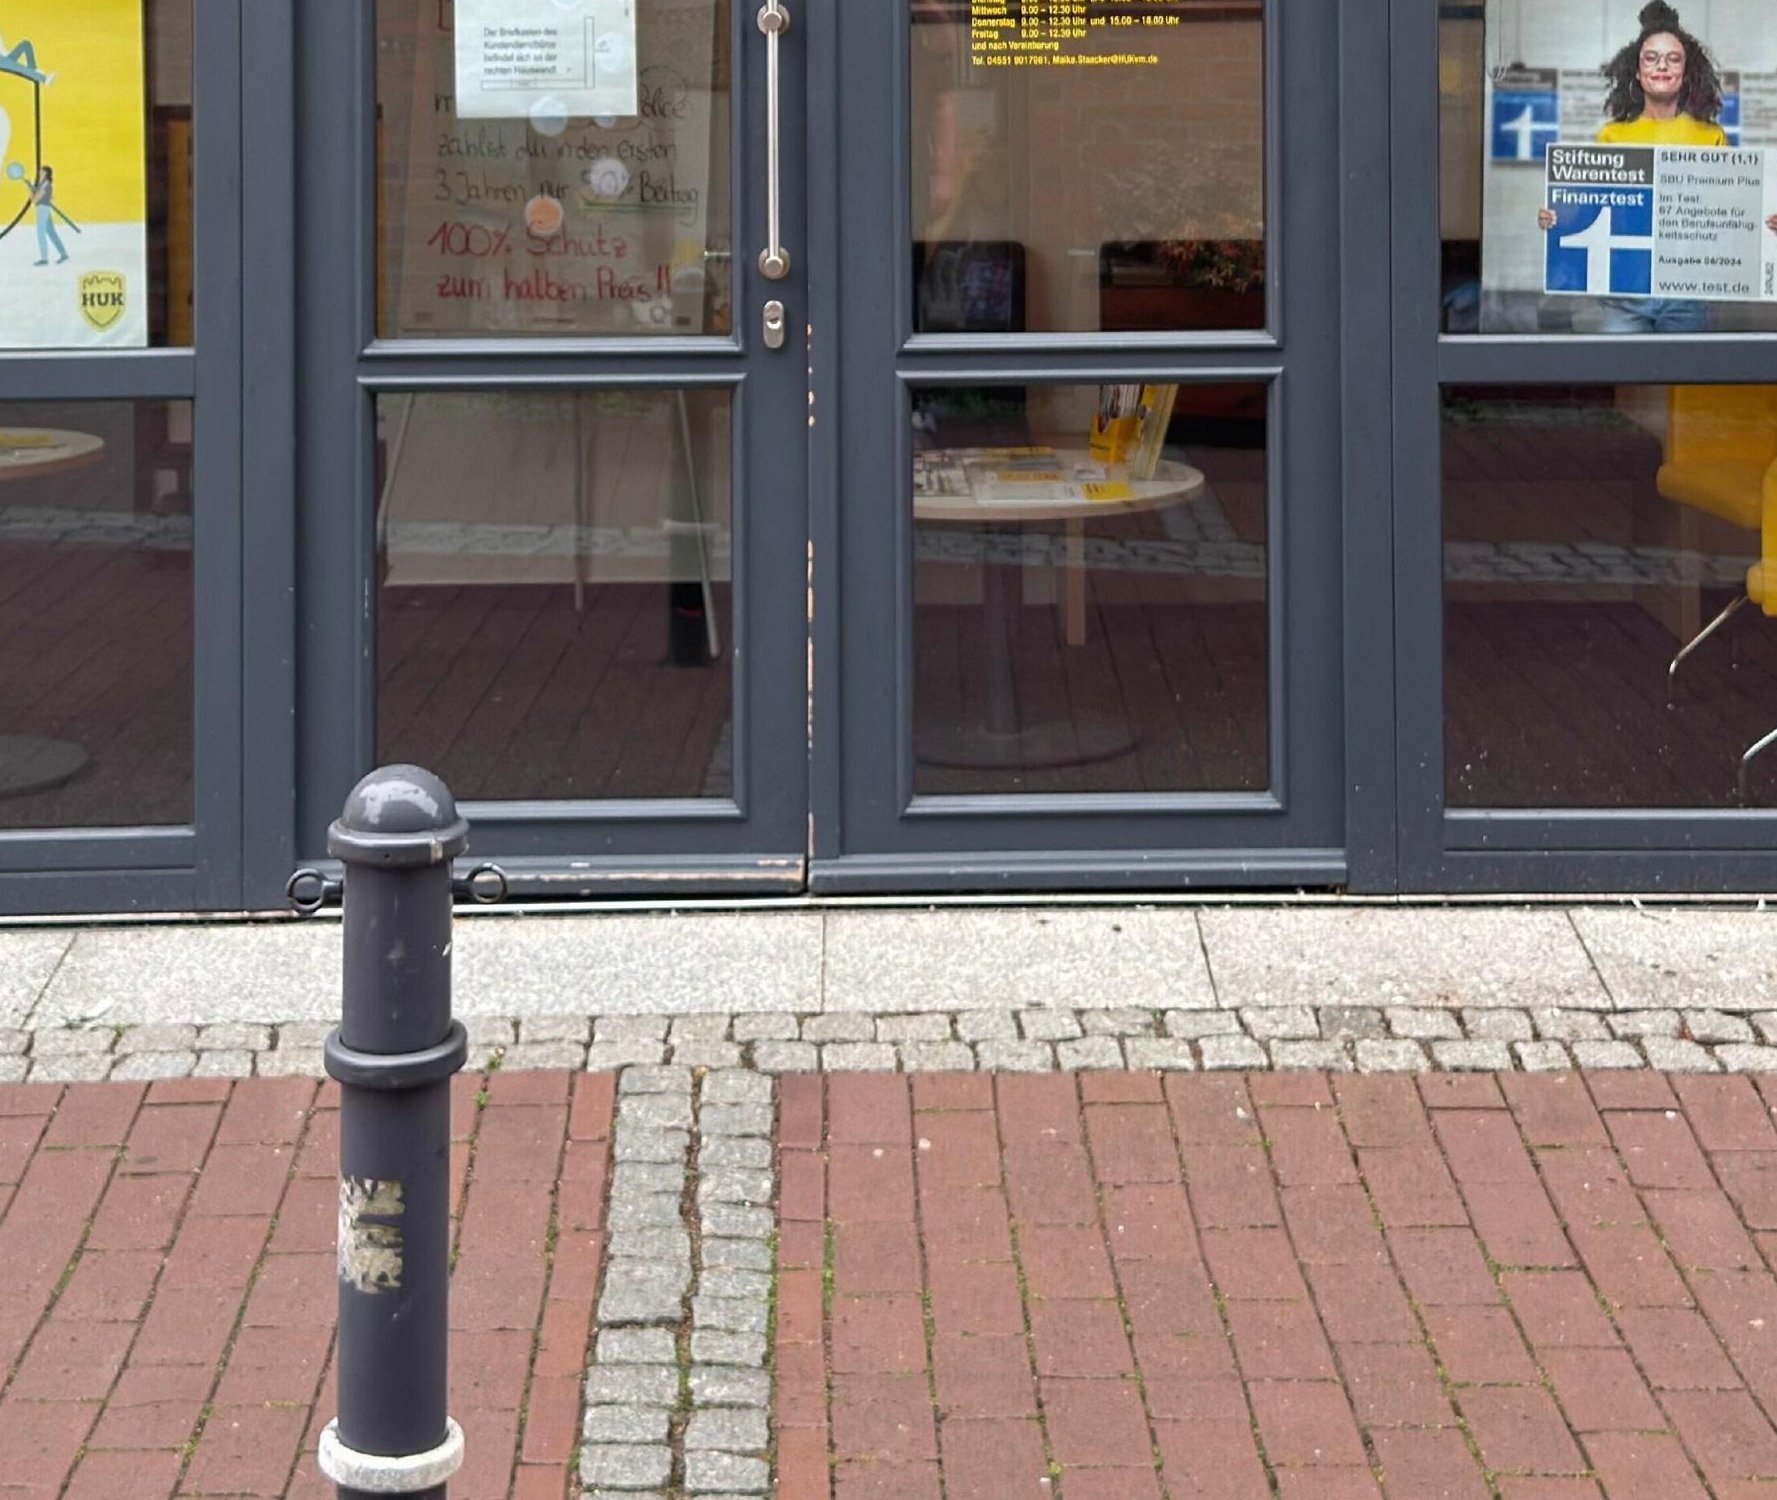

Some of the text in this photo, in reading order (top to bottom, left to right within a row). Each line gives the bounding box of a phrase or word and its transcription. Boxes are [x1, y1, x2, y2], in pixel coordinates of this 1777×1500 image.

[972, 5, 1007, 15] Mittwoch
[1048, 5, 1070, 14] 12.30
[1072, 4, 1086, 13] Uhr
[972, 17, 1016, 27] Donnerstag
[1048, 17, 1070, 26] 12.30
[1072, 16, 1086, 25] Uhr
[1090, 16, 1105, 25] und
[1110, 16, 1131, 25] 15.00
[1165, 16, 1179, 24] Uhr
[972, 29, 998, 39] Freitag
[1048, 29, 1070, 38] 12.30
[1072, 28, 1086, 37] Uhr
[989, 42, 1007, 50] nach
[1552, 149, 1624, 167] Stiftung
[1661, 152, 1697, 162] SEHR
[1701, 152, 1729, 163] GUT
[1552, 166, 1645, 183] Warentest
[1738, 176, 1760, 186] Plus
[1552, 190, 1644, 206] Finanztest
[427, 221, 512, 256] 100%
[1659, 282, 1749, 294] www.test.de
[82, 293, 124, 307] HUK
